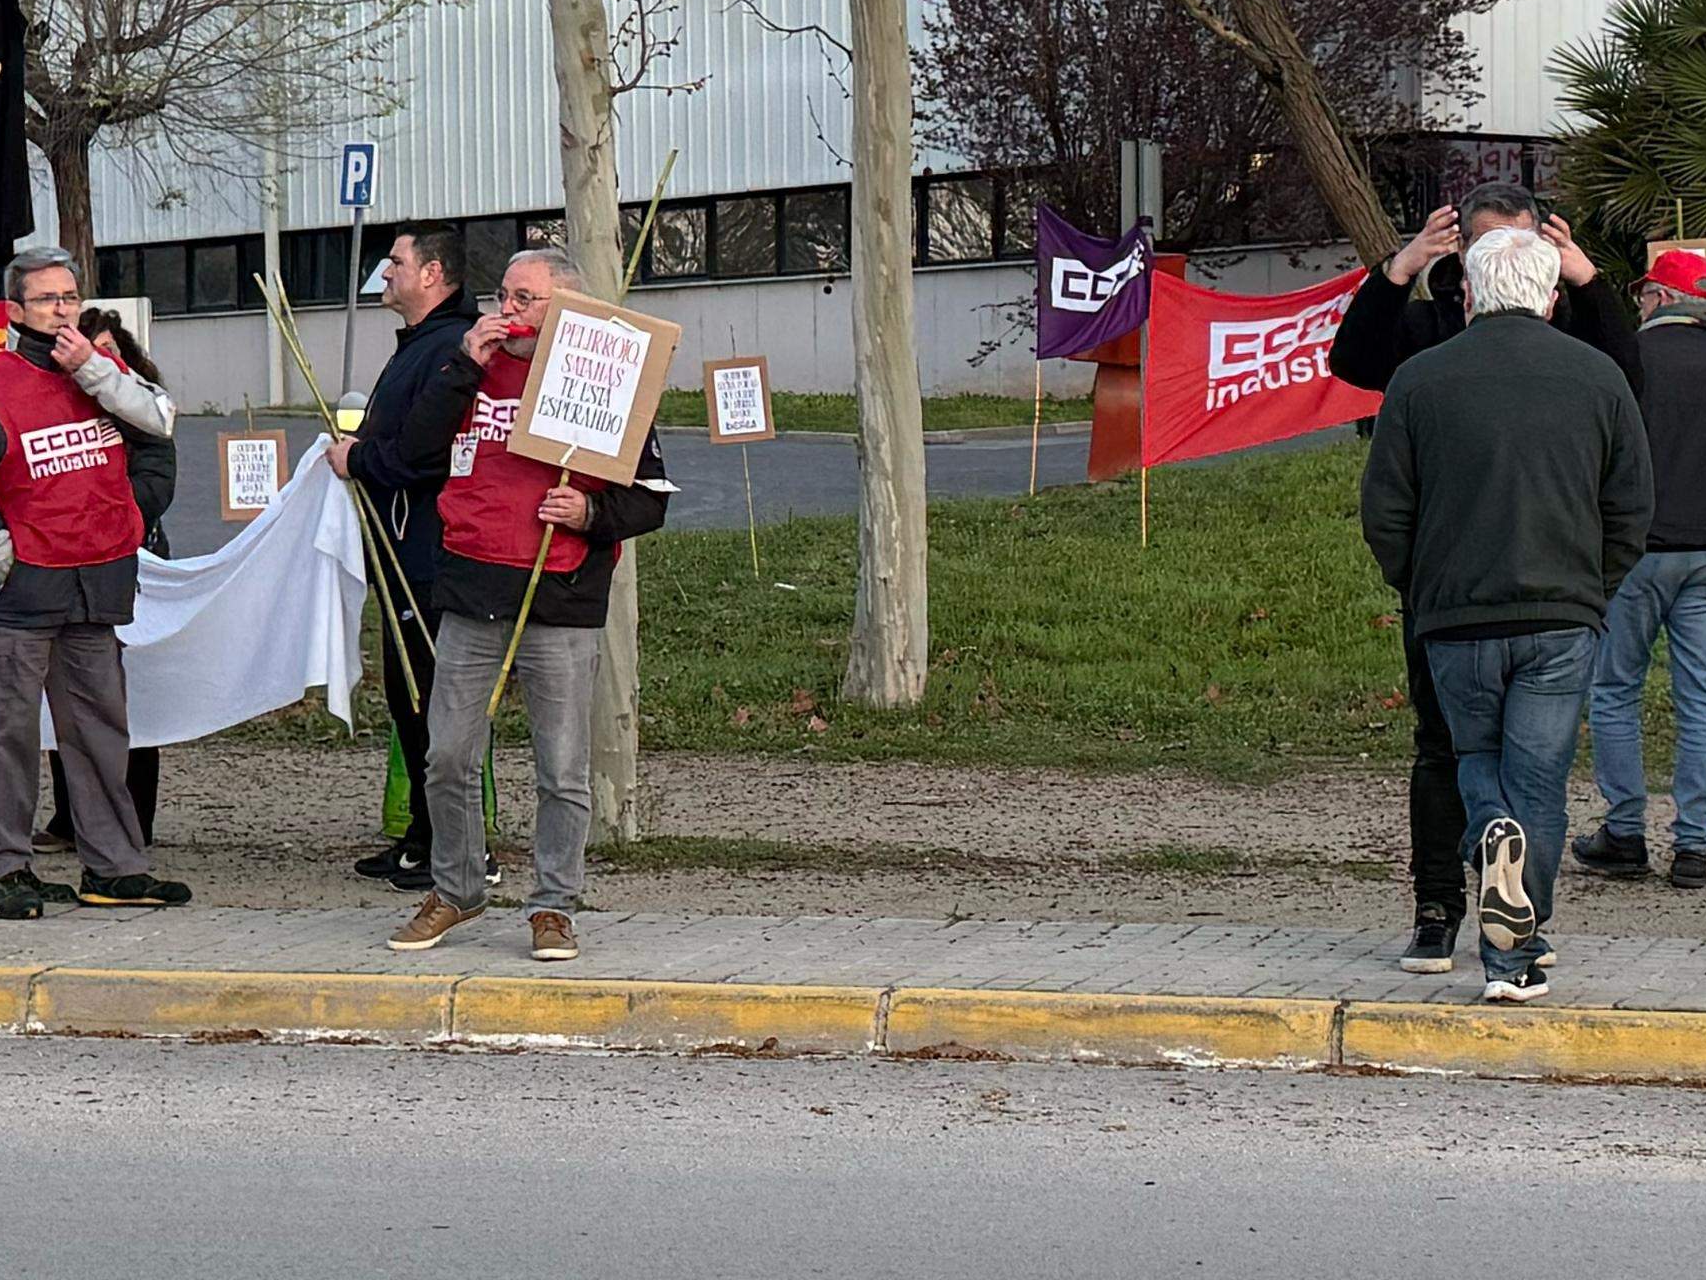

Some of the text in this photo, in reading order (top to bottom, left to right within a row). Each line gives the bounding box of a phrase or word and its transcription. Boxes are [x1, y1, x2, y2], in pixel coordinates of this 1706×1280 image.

[346, 151, 368, 201] P
[537, 395, 623, 435] ESPERANDO
[29, 426, 99, 455] CCOO
